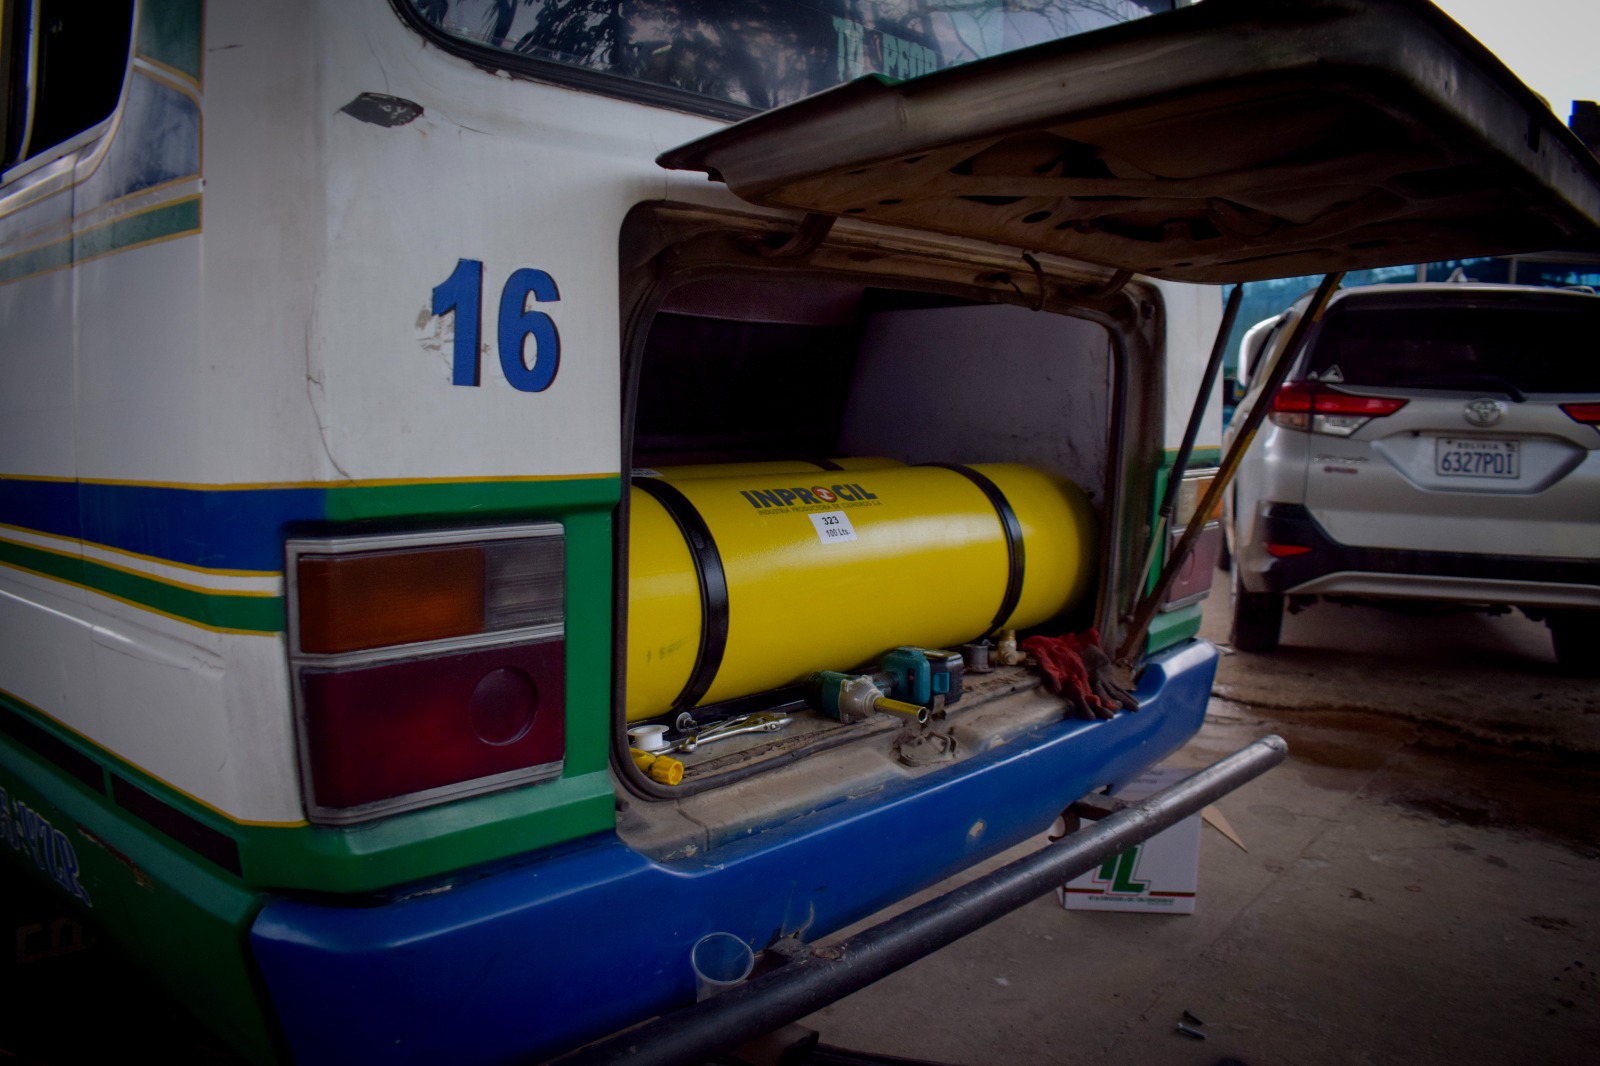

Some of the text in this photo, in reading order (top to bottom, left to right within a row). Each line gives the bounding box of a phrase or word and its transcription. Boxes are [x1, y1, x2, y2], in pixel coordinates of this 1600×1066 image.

[432, 258, 561, 392] 16
[821, 515, 840, 525] 323
[826, 528, 839, 537] 100
